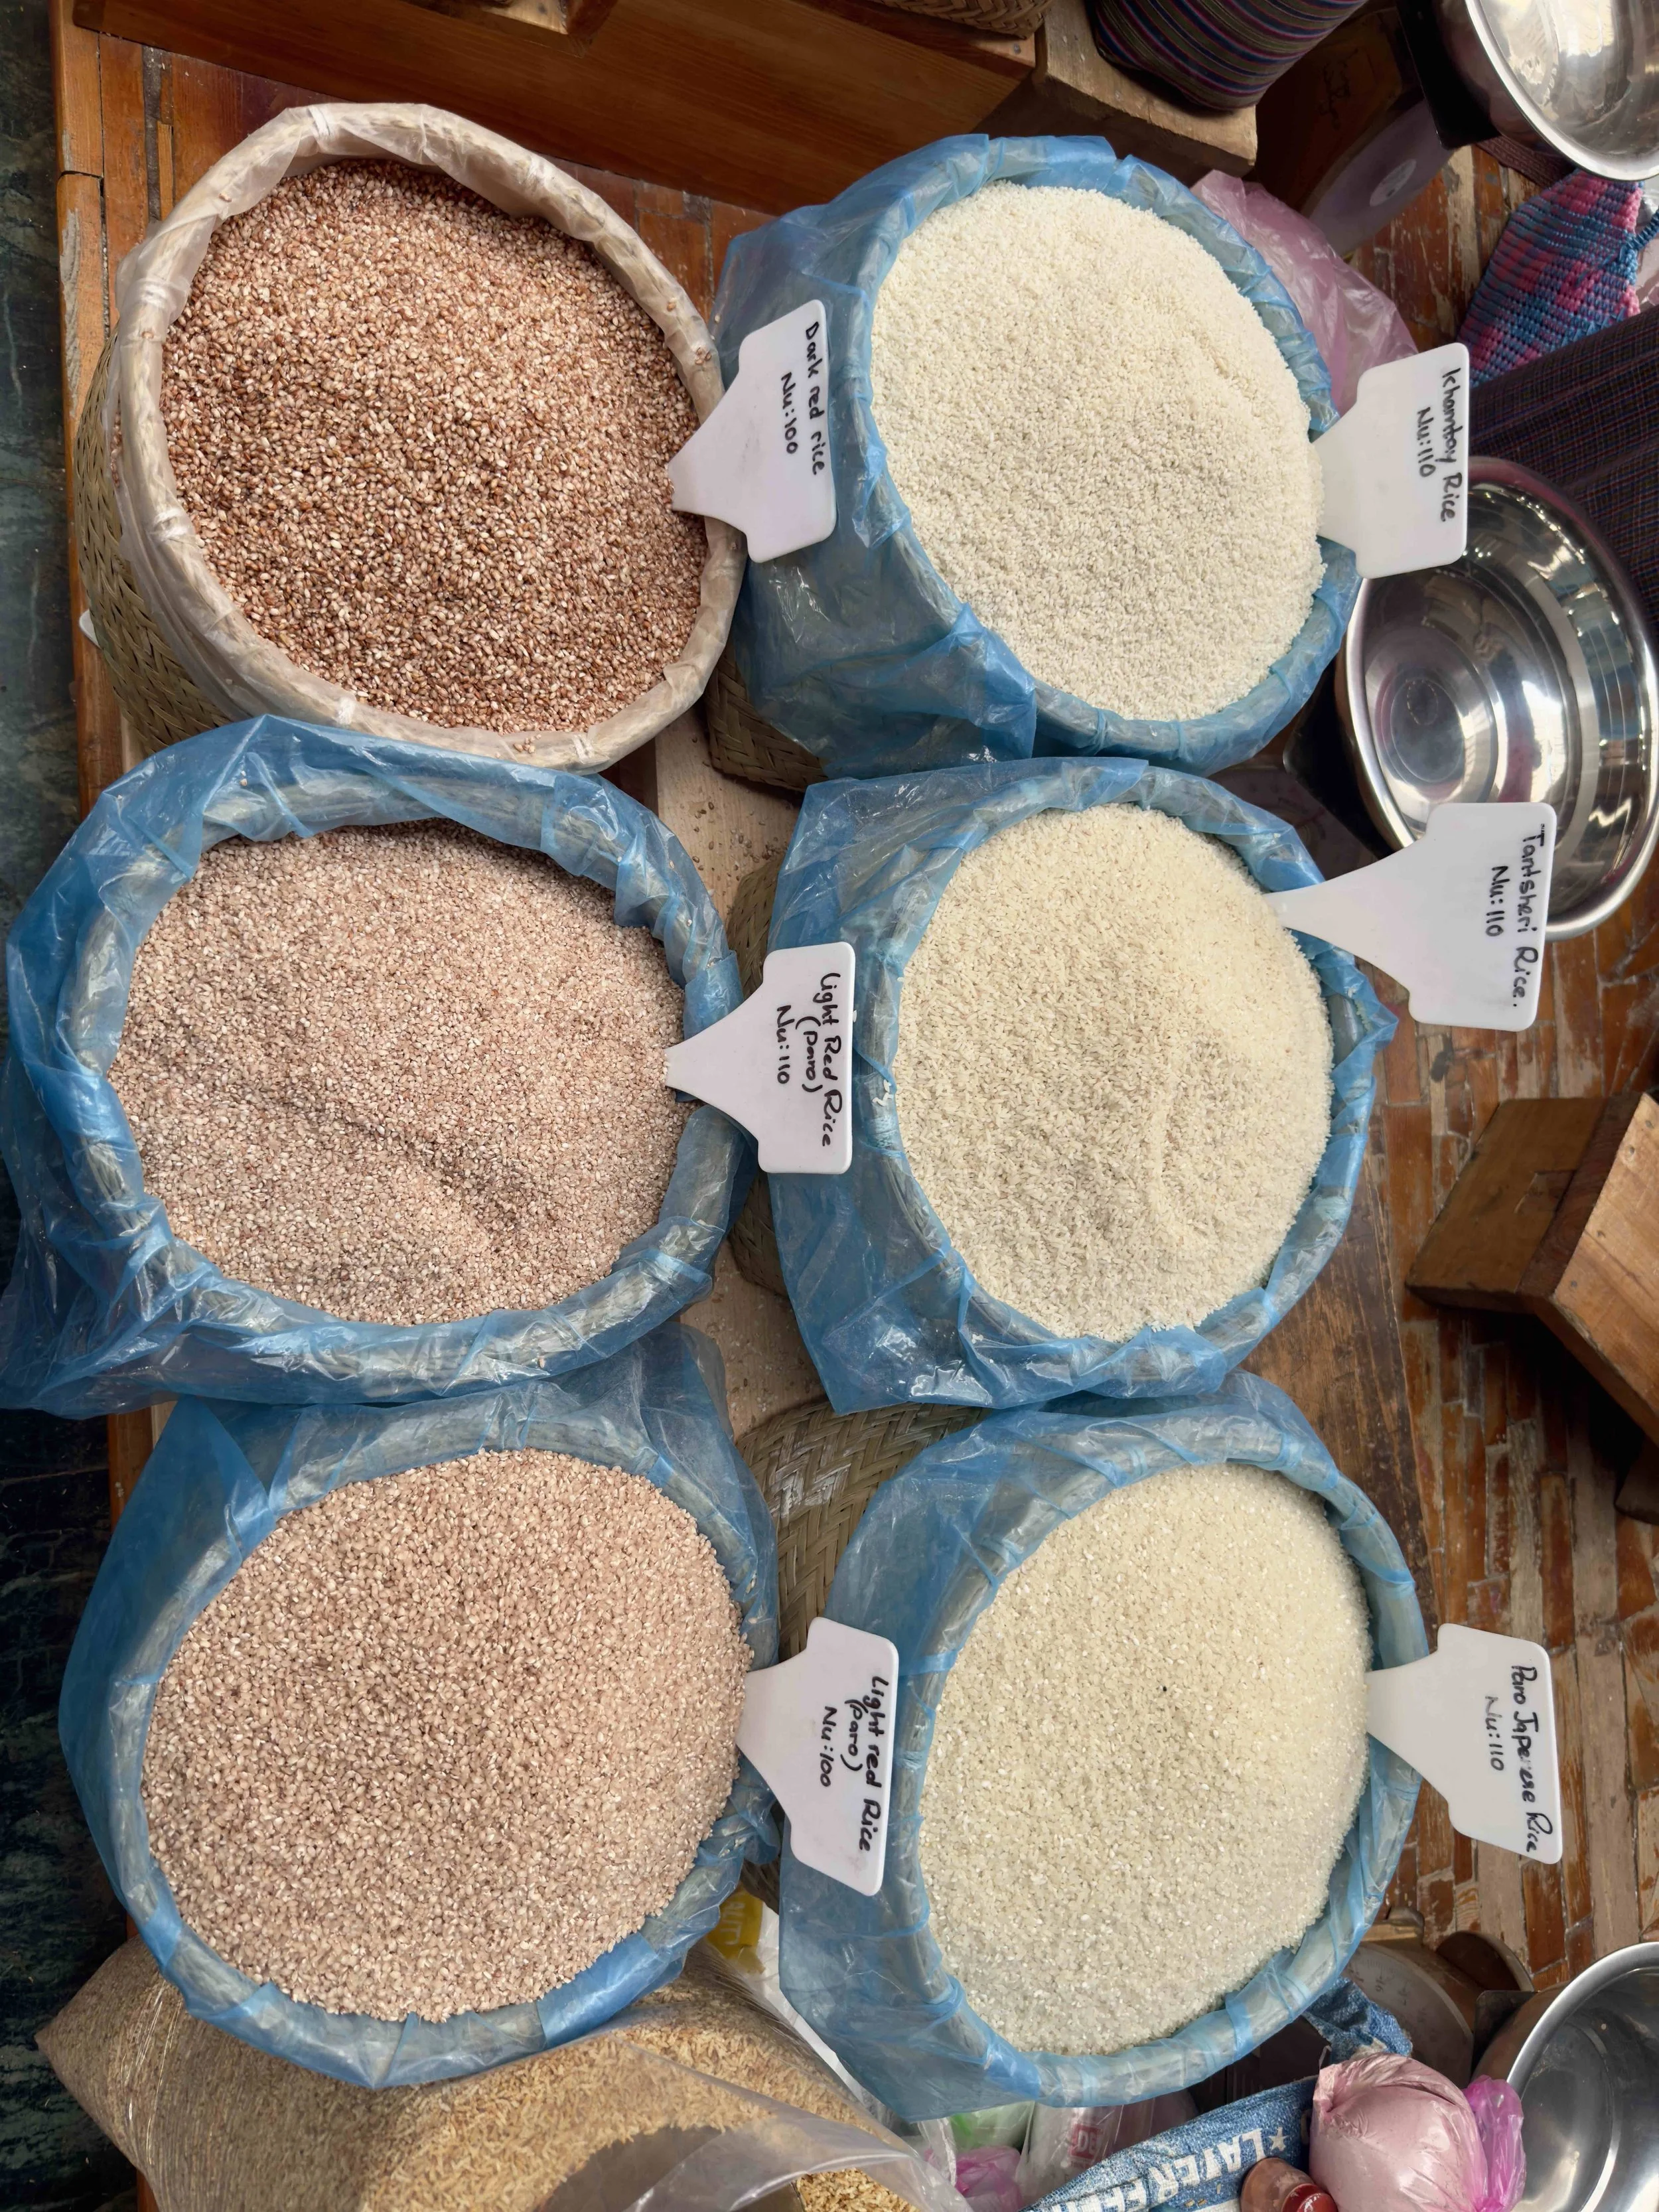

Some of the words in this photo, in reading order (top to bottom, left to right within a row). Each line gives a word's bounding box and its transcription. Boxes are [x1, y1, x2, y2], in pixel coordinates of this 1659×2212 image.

[806, 321, 823, 378] Dark
[781, 372, 798, 455] Nu:100
[808, 386, 825, 419] red
[811, 431, 828, 476] rice
[1416, 407, 1436, 477] Nu:110
[1440, 472, 1463, 522] Rice
[1484, 866, 1509, 937] Nu:110
[813, 973, 841, 1025] Light
[776, 1005, 795, 1084] Nu:110
[823, 1035, 842, 1081] Red
[820, 1089, 842, 1147] Rice
[840, 1699, 867, 1771] (Paro)
[862, 1676, 889, 1737] Light
[1485, 1696, 1504, 1771] Nu:110
[820, 1706, 837, 1787] Nu:100
[865, 1745, 882, 1788] red
[1511, 1666, 1538, 1704] Paro
[1526, 1812, 1553, 1852] Rice
[859, 1799, 881, 1851] Rice
[1148, 2127, 1267, 2198] LAYER
